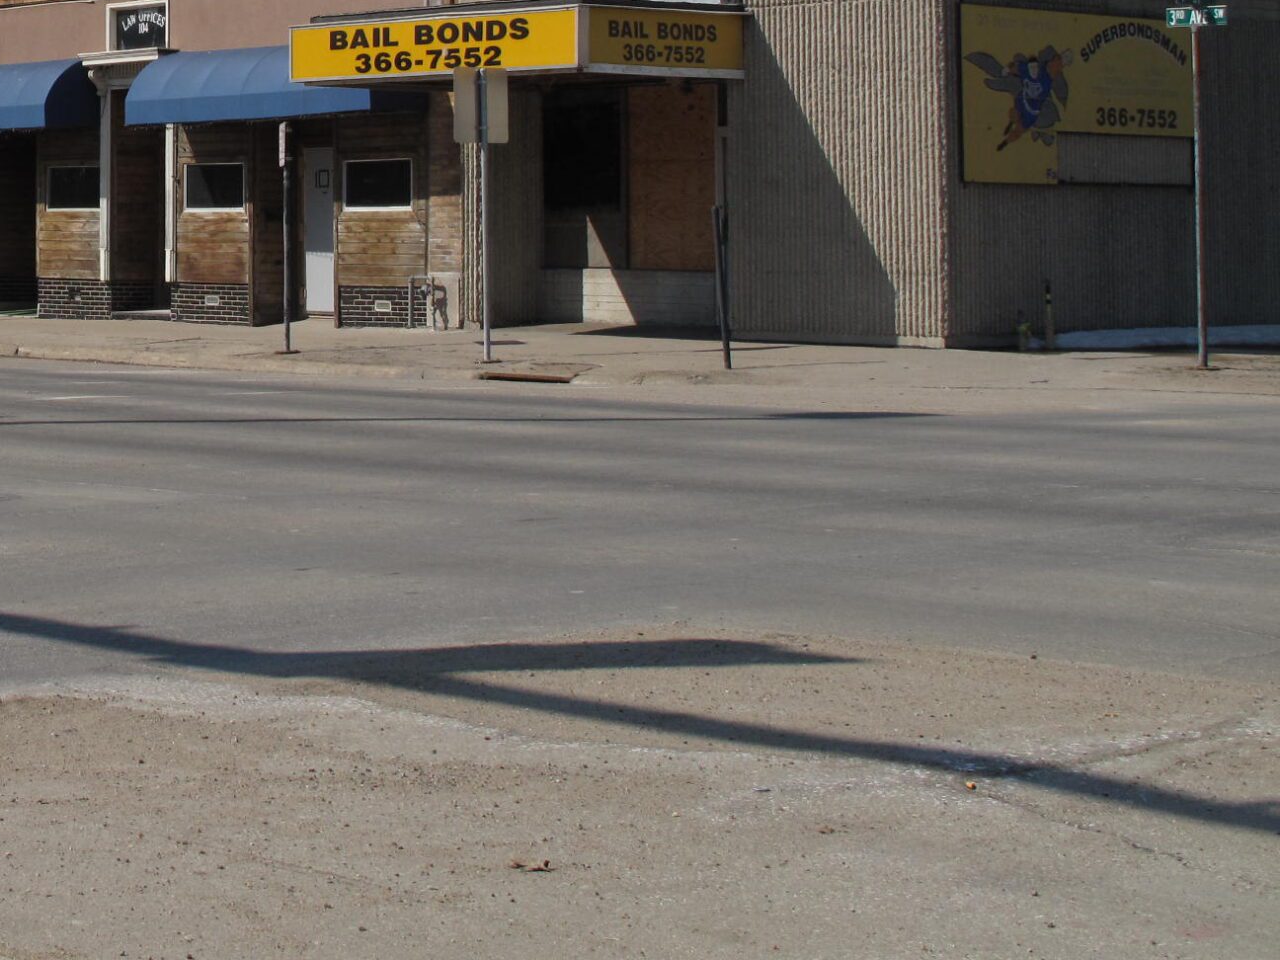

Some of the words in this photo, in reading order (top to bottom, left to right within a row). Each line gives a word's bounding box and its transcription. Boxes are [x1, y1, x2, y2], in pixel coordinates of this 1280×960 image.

[122, 14, 136, 31] LAW
[138, 12, 166, 28] OFFICES
[1190, 9, 1208, 25] AVE
[1213, 8, 1224, 18] SW
[138, 23, 149, 34] 104
[330, 27, 399, 50] BAIL
[414, 18, 530, 45] BONDS
[608, 20, 649, 39] BAIL
[657, 22, 717, 42] BONDS
[623, 44, 705, 63] 366-7552
[1080, 23, 1188, 67] SUPERBONDSMAN
[355, 46, 501, 73] 366-7552
[1096, 107, 1178, 129] 366-7552
